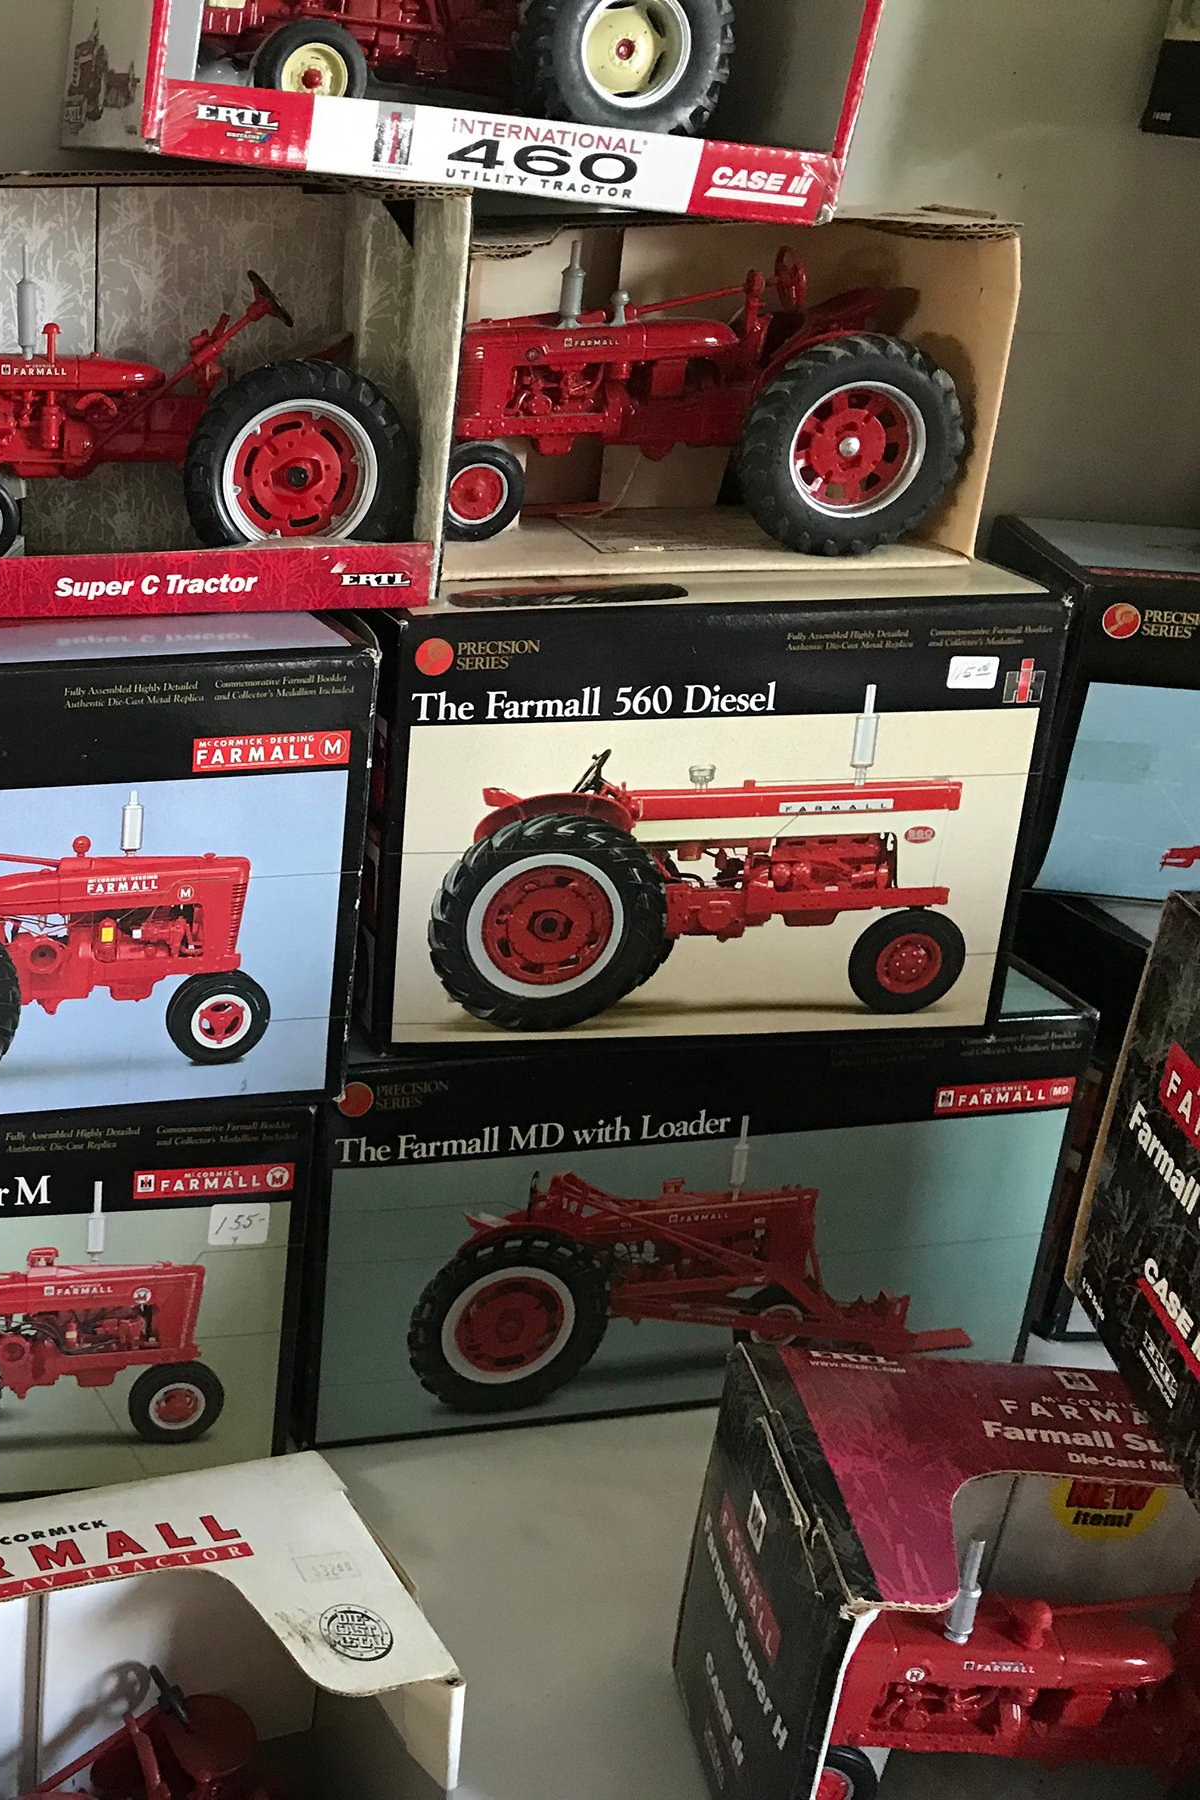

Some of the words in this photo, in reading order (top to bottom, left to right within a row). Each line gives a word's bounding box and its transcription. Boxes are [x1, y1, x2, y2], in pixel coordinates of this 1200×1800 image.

[196, 103, 279, 131] ERTL
[447, 138, 638, 184] 460
[445, 168, 528, 187] UTILITY
[540, 179, 632, 199] TRACTOR
[711, 166, 784, 192] CASE
[573, 338, 621, 348] FARMALL
[13, 366, 68, 376] FARMALL
[54, 576, 134, 601] Super
[140, 575, 160, 596] C
[166, 574, 258, 595] Tractor
[340, 572, 412, 588] ERTL
[1143, 609, 1200, 626] PRECISI
[1141, 623, 1192, 639] SERIES
[456, 639, 541, 656] PRECISION
[455, 654, 510, 671] SERIES
[64, 687, 86, 698] Fully
[88, 684, 132, 696] Assembled
[134, 682, 161, 694] Highly
[214, 678, 281, 690] Commemorative
[282, 675, 315, 686] Farmall
[107, 696, 144, 707] Die-Cast
[214, 691, 230, 701] and
[232, 688, 274, 700] Collector's
[411, 689, 475, 722] The
[484, 686, 602, 720] Farmall
[612, 684, 673, 717] 560
[682, 681, 778, 715] Diesel
[198, 737, 263, 749] McCORMICK
[270, 734, 315, 745] DEERING
[323, 738, 342, 756] M
[196, 743, 315, 766] FARMALL
[784, 802, 888, 813] FARMALL
[86, 879, 159, 894] FARMALL
[180, 888, 191, 899] M
[376, 1079, 449, 1097] PRECISION
[1052, 1085, 1069, 1096] MD
[375, 1095, 423, 1109] SERIES
[957, 1088, 1046, 1107] FARMALL
[335, 1138, 392, 1163] The
[397, 1126, 500, 1161] Farmall
[508, 1122, 564, 1152] MD
[573, 1116, 631, 1146] with
[640, 1109, 732, 1141] Loader
[1128, 1099, 1200, 1216] Farmall
[13, 1175, 51, 1206] M
[160, 1174, 262, 1192] FARMALL
[56, 1285, 113, 1296] FARMALL
[1143, 1257, 1195, 1340] CASE
[999, 1398, 1151, 1426] FARMA
[982, 1419, 1116, 1449] Farmall
[1066, 1452, 1147, 1471] Die-Cast
[1066, 1480, 1156, 1511] NEW
[81, 1545, 245, 1580] TRACTOR
[975, 1663, 1036, 1675] FARMALL
[735, 1617, 774, 1716] Super
[771, 1713, 789, 1751] H
